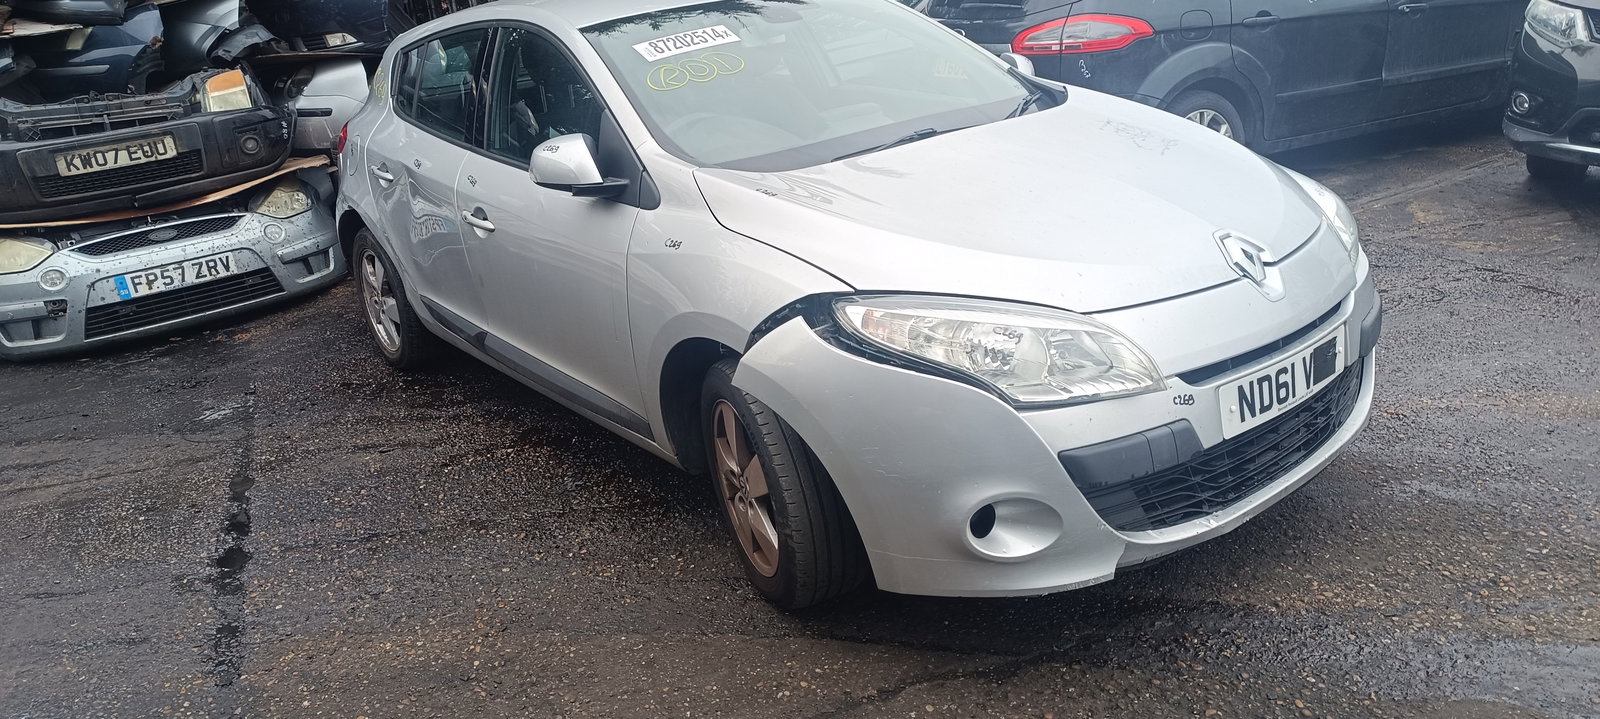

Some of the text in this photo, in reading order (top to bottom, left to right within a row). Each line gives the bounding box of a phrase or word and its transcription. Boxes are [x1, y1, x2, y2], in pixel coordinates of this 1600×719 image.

[63, 147, 119, 172] KW07
[665, 237, 682, 250] C269
[130, 265, 186, 293] FP57
[192, 255, 231, 280] ZRV
[992, 326, 1024, 345] C269
[1172, 394, 1195, 406] C269
[1237, 361, 1297, 423] ND61
